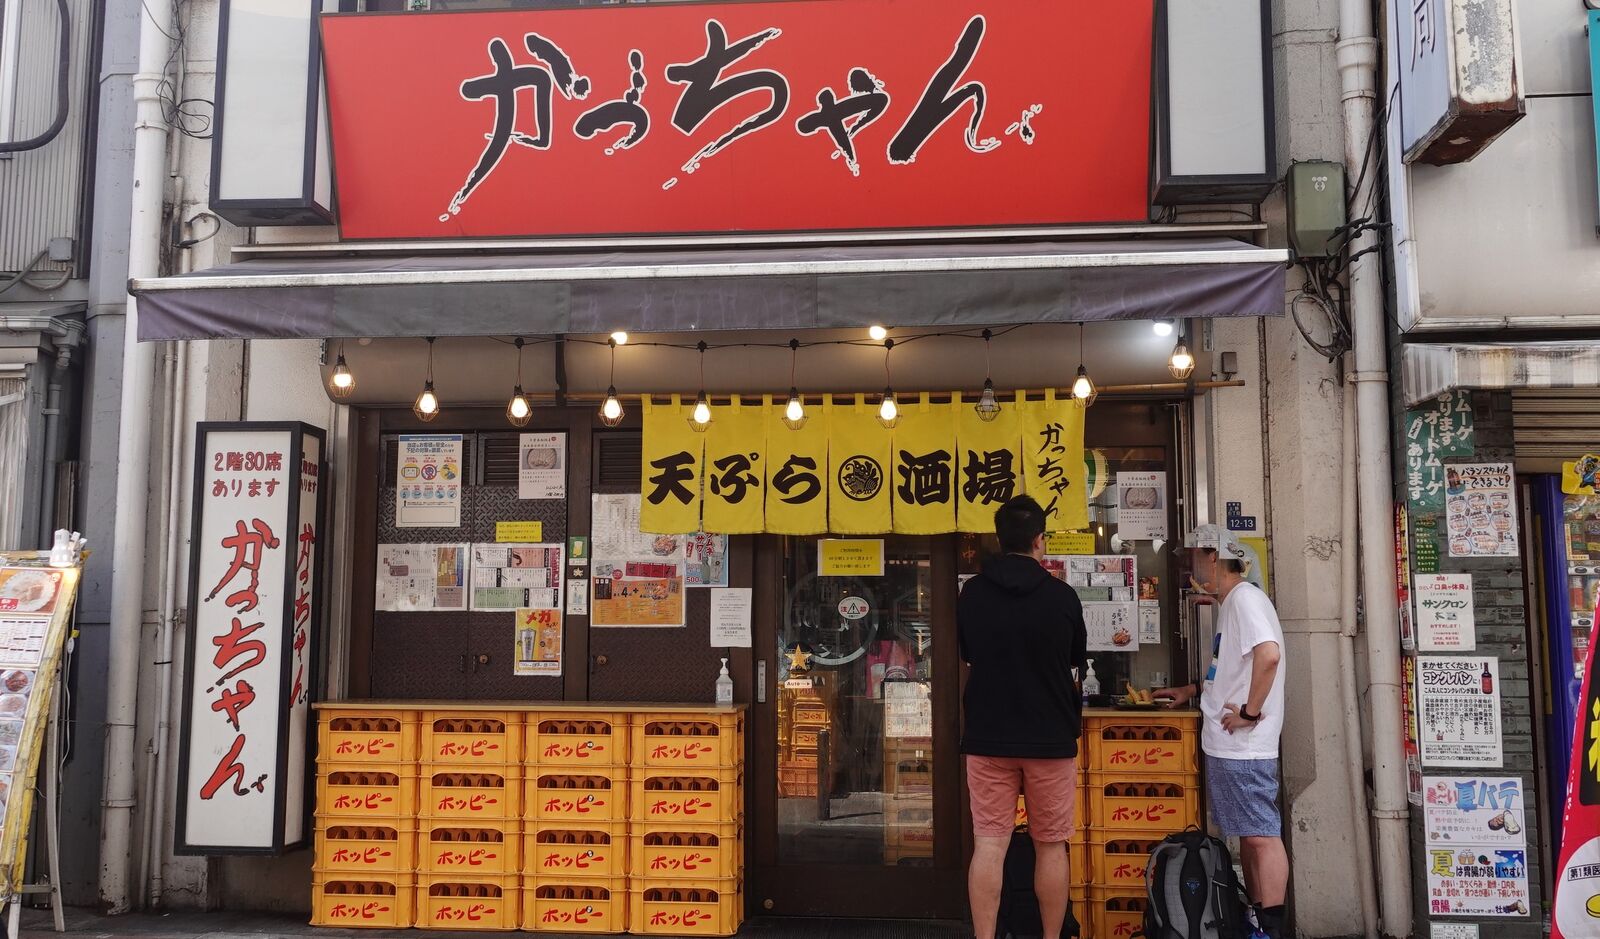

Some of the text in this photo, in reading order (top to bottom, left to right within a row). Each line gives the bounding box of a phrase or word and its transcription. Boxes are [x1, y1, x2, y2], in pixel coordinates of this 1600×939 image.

[438, 16, 1042, 223] かっちゃん
[1424, 410, 1444, 496] オードムーゲ
[213, 450, 284, 473] 2階30席
[646, 448, 1018, 507] 天ぷら 酒場
[1034, 421, 1071, 521] かっちゃん
[211, 477, 281, 499] あります
[1230, 519, 1255, 528] 12-13
[201, 517, 281, 801] かっちゃん
[337, 740, 394, 754] ホッピー
[441, 741, 498, 756] ホッピー
[652, 744, 711, 758] ホッピー
[1110, 748, 1174, 764] ホッピー
[335, 793, 392, 808] ホッピー
[439, 796, 497, 810] ホッピー
[1455, 780, 1521, 812] 夏バテ
[652, 798, 711, 814] ホッピー
[1112, 805, 1176, 821] ホッピー
[333, 848, 391, 863] ホッピー
[438, 850, 496, 865] ホッピー
[651, 854, 711, 870] ホッピー
[1430, 850, 1455, 877] 夏
[331, 903, 389, 918] ホッピー
[436, 904, 495, 920] ホッピー
[651, 910, 711, 926] ホッピー
